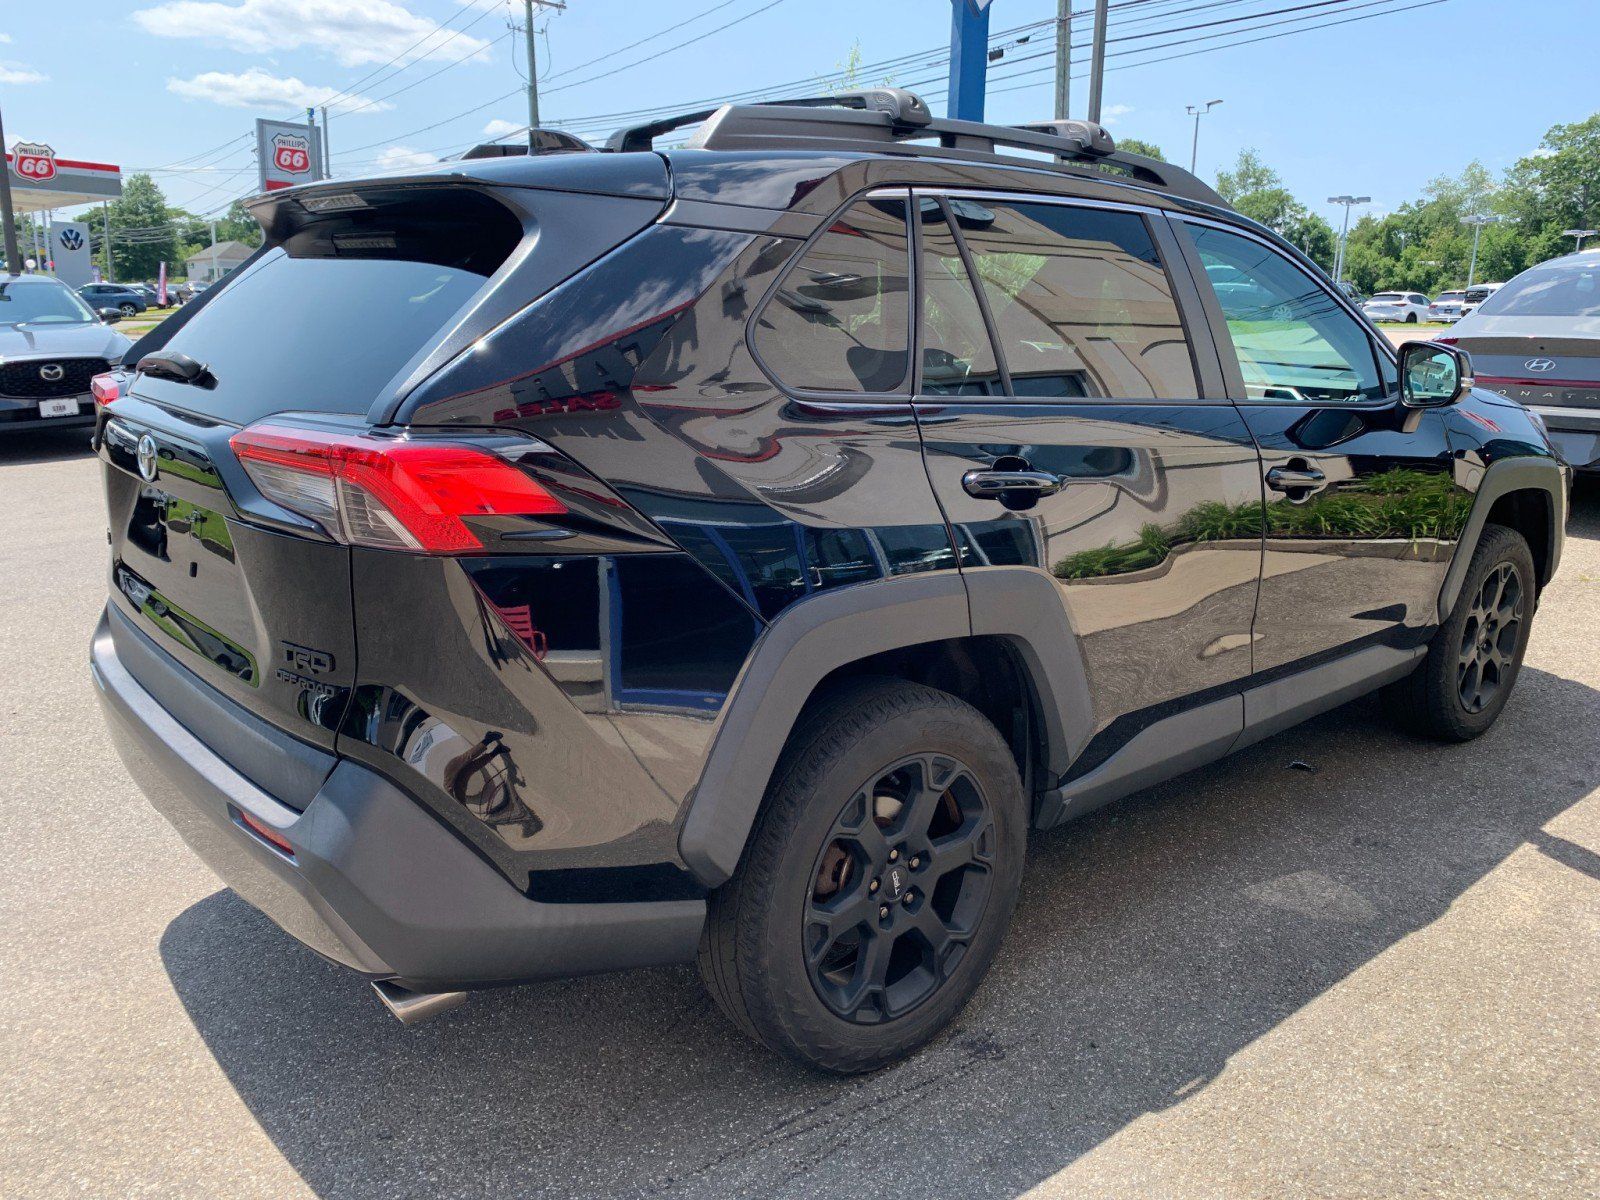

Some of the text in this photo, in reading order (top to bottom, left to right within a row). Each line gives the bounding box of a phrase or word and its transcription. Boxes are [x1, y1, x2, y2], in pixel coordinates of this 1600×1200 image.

[18, 147, 50, 157] PHILLIPS
[276, 138, 306, 149] PHILLIPS
[21, 158, 49, 175] 66
[280, 150, 305, 168] 66
[1497, 389, 1598, 401] ONATA
[281, 640, 336, 675] TRD
[275, 668, 335, 699] OFF ROAD
